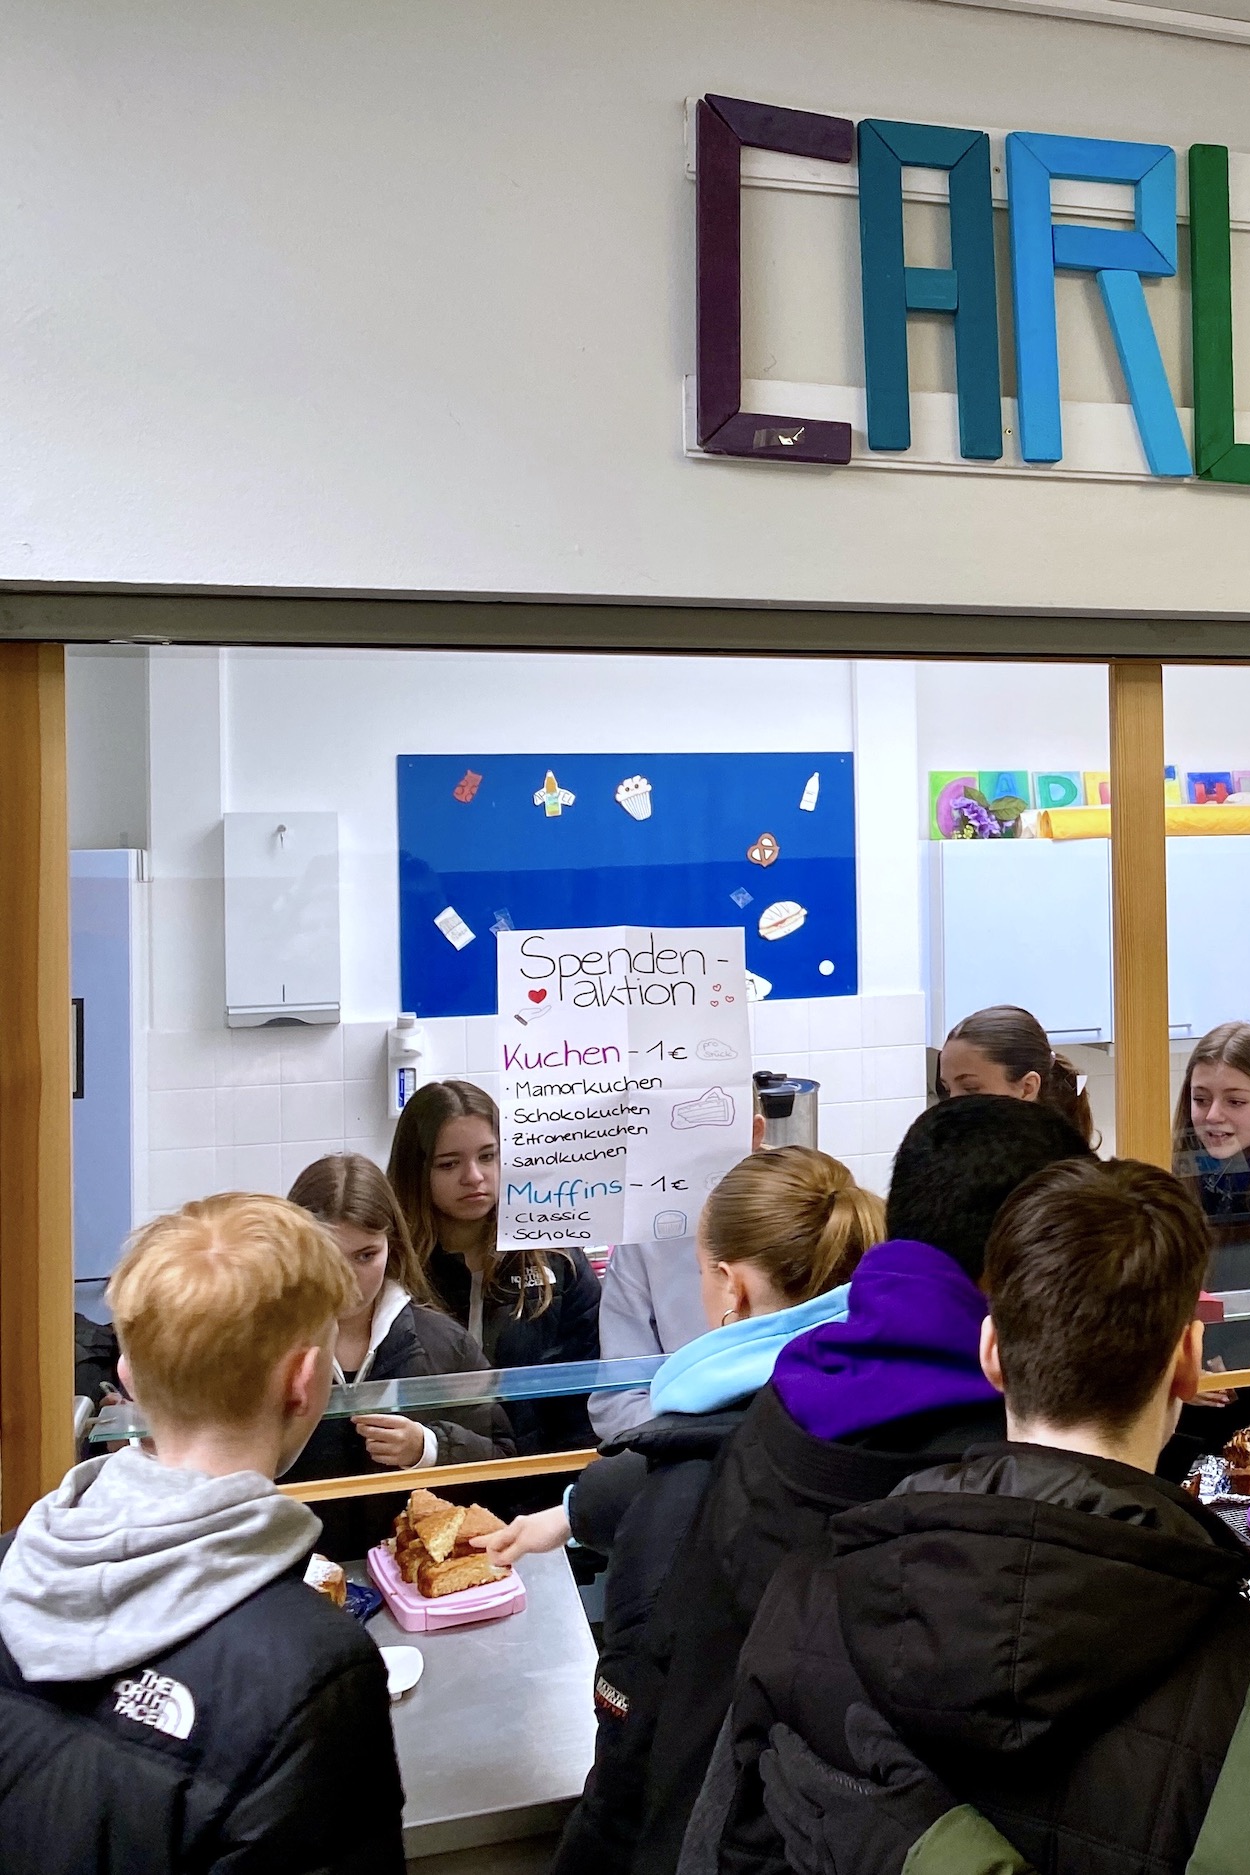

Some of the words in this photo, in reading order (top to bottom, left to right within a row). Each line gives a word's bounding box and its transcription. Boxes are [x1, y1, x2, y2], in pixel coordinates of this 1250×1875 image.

[573, 976, 696, 1007] aktion
[503, 1040, 620, 1070] Kuchen
[516, 1075, 662, 1099] Mamorkuchen
[513, 1104, 650, 1124] Schokokuchen
[511, 1124, 648, 1146] Zitronenkuchen
[507, 1179, 623, 1208] Muffins
